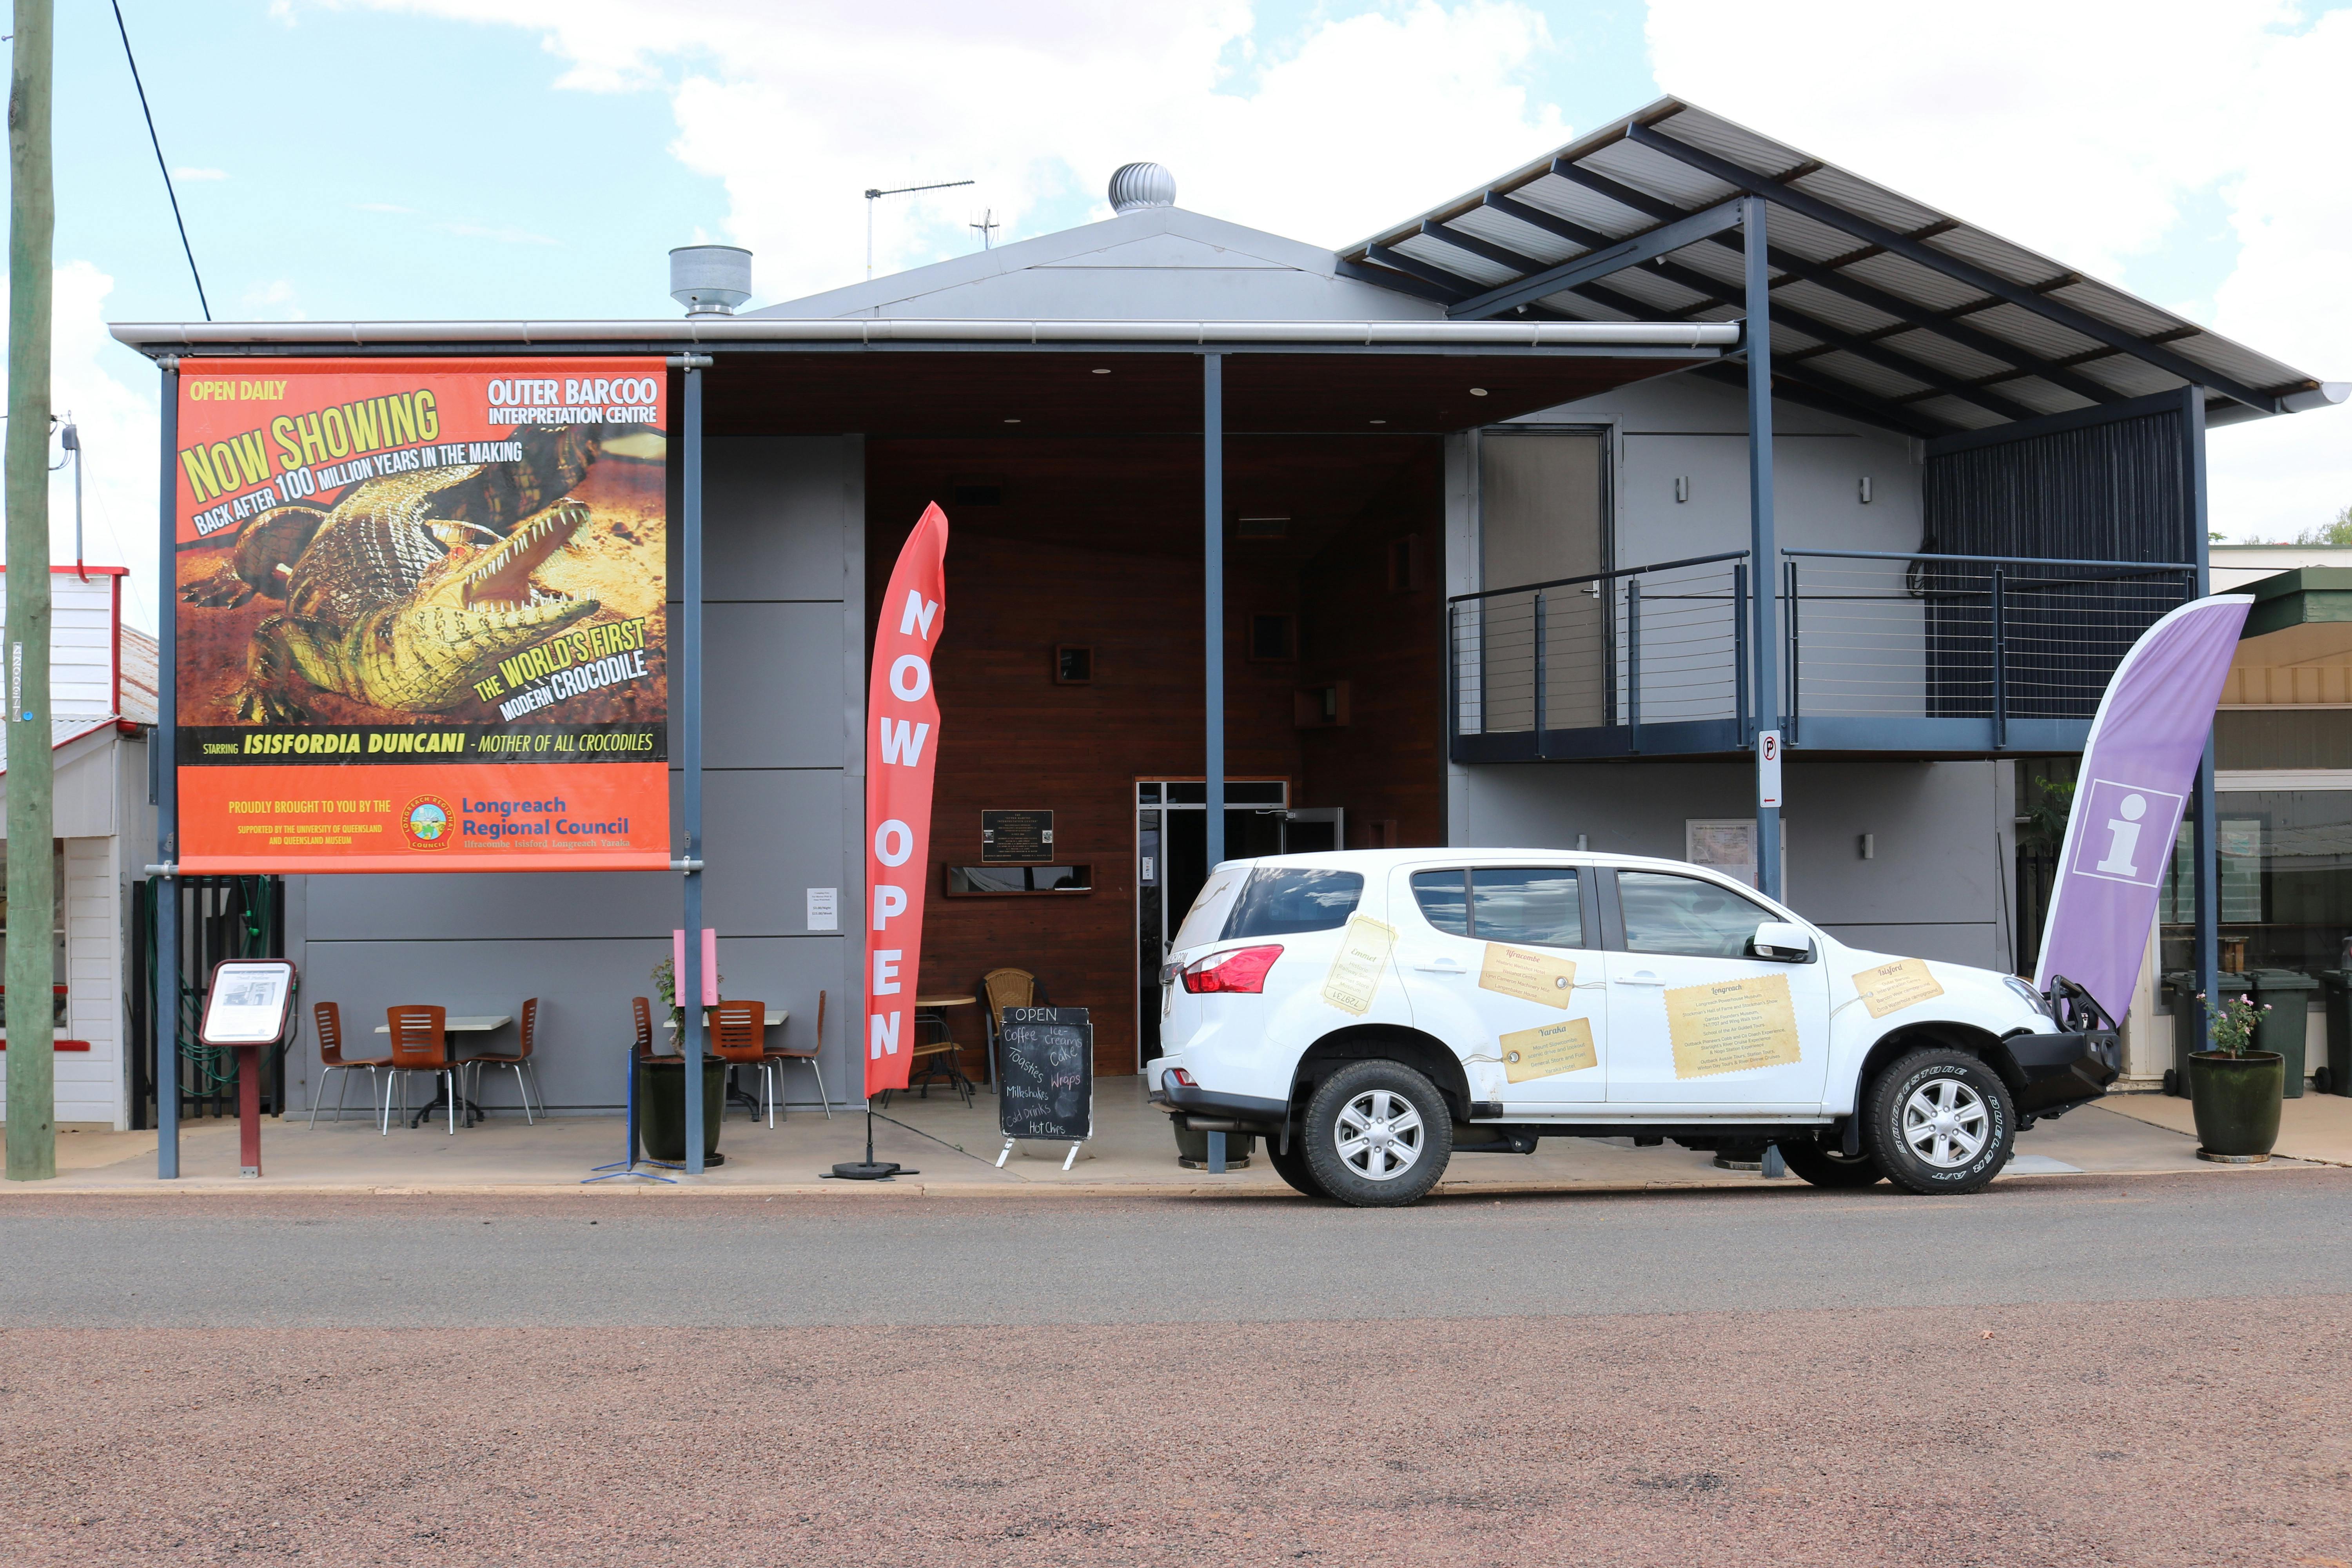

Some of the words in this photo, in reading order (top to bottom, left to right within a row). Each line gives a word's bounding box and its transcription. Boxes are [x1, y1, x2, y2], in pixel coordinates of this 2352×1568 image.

[190, 381, 235, 401] OPEN
[240, 381, 287, 400] DAILY
[488, 379, 559, 405] OUTER
[565, 378, 657, 405] BARCOO
[488, 407, 602, 425] INTERPRETATION
[606, 406, 657, 423] CENTRE
[180, 429, 271, 503] NOW
[272, 389, 439, 470] SHOWING
[194, 502, 234, 536] BACK
[232, 488, 277, 520] AFTER
[275, 467, 315, 502] 100
[317, 461, 374, 491] MILLION
[373, 449, 419, 476] YEARS
[421, 447, 437, 467] IN
[438, 445, 466, 465] THE
[469, 442, 523, 463] MAKING
[473, 675, 505, 702] THE
[498, 632, 589, 688] WORLD'S
[588, 619, 645, 657] FIRST
[499, 685, 554, 722] MODERN
[550, 650, 648, 700] CROCODILE
[880, 589, 939, 767] NOW
[203, 744, 239, 755] STARRING
[244, 734, 361, 754] ISISFORDIA
[367, 733, 465, 753] DUNCANI
[478, 735, 531, 752] MOTHER
[535, 735, 552, 752] OF
[554, 735, 575, 751] ALL
[578, 733, 653, 751] CROCODILES
[229, 801, 272, 814] PROUDLY
[275, 801, 319, 813] BROUGHT
[321, 801, 334, 813] TO
[336, 801, 356, 813] YOU
[359, 800, 372, 813] BY
[374, 800, 391, 812] THE
[403, 797, 429, 833] LONGREACH
[432, 797, 454, 831] REGIONAL
[463, 797, 566, 817] Longreach
[238, 826, 273, 835] SUPPORTED
[275, 826, 283, 834] BY
[284, 825, 295, 833] THE
[297, 825, 332, 834] UNIVERSITY
[333, 825, 341, 833] OF
[342, 825, 382, 833] QUEENSLAND
[463, 818, 549, 839] Regional
[555, 818, 628, 835] Council
[269, 837, 283, 845] AND
[284, 836, 324, 845] QUEENSLAND
[325, 836, 352, 845] MUSEUM
[552, 840, 597, 849] Longreach
[871, 818, 913, 1059] OPEN
[1351, 948, 1376, 962] Emmet
[1506, 949, 1540, 962] Ilfracombe
[1338, 964, 1357, 976] Railway
[1349, 961, 1368, 973] Historic
[1502, 969, 1521, 977] Wellshot
[1878, 964, 1902, 976] Isisford
[1336, 973, 1354, 984] Emmet
[1356, 981, 1369, 989] Store
[1339, 982, 1361, 993] Museum
[1494, 983, 1523, 994] Langenbaker
[1497, 975, 1516, 984] Cameron
[1517, 980, 1539, 991] Machinery
[1711, 984, 1742, 995] Longreach
[1887, 997, 1910, 1007] Waterhole
[1911, 988, 1938, 999] campground
[1333, 991, 1359, 1007] 729731
[1015, 1008, 1057, 1022] OPEN
[1004, 1027, 1038, 1044] Coffee
[1538, 1026, 1566, 1036] Yaraka
[1045, 1035, 1083, 1048] Creams
[1009, 1047, 1044, 1083] Toasties
[1050, 1045, 1078, 1067] Cake
[1530, 1059, 1550, 1067] General
[1051, 1073, 1081, 1091] Wraps
[1006, 1085, 1049, 1101] Milkshakes
[1006, 1112, 1022, 1127] Cold
[1024, 1103, 1051, 1118] Drinks
[1892, 1065, 1967, 1154] BRIDGESTONE
[1029, 1120, 1043, 1134] Hot
[1045, 1121, 1066, 1135] Chips
[1973, 1095, 2002, 1173] DUELER
